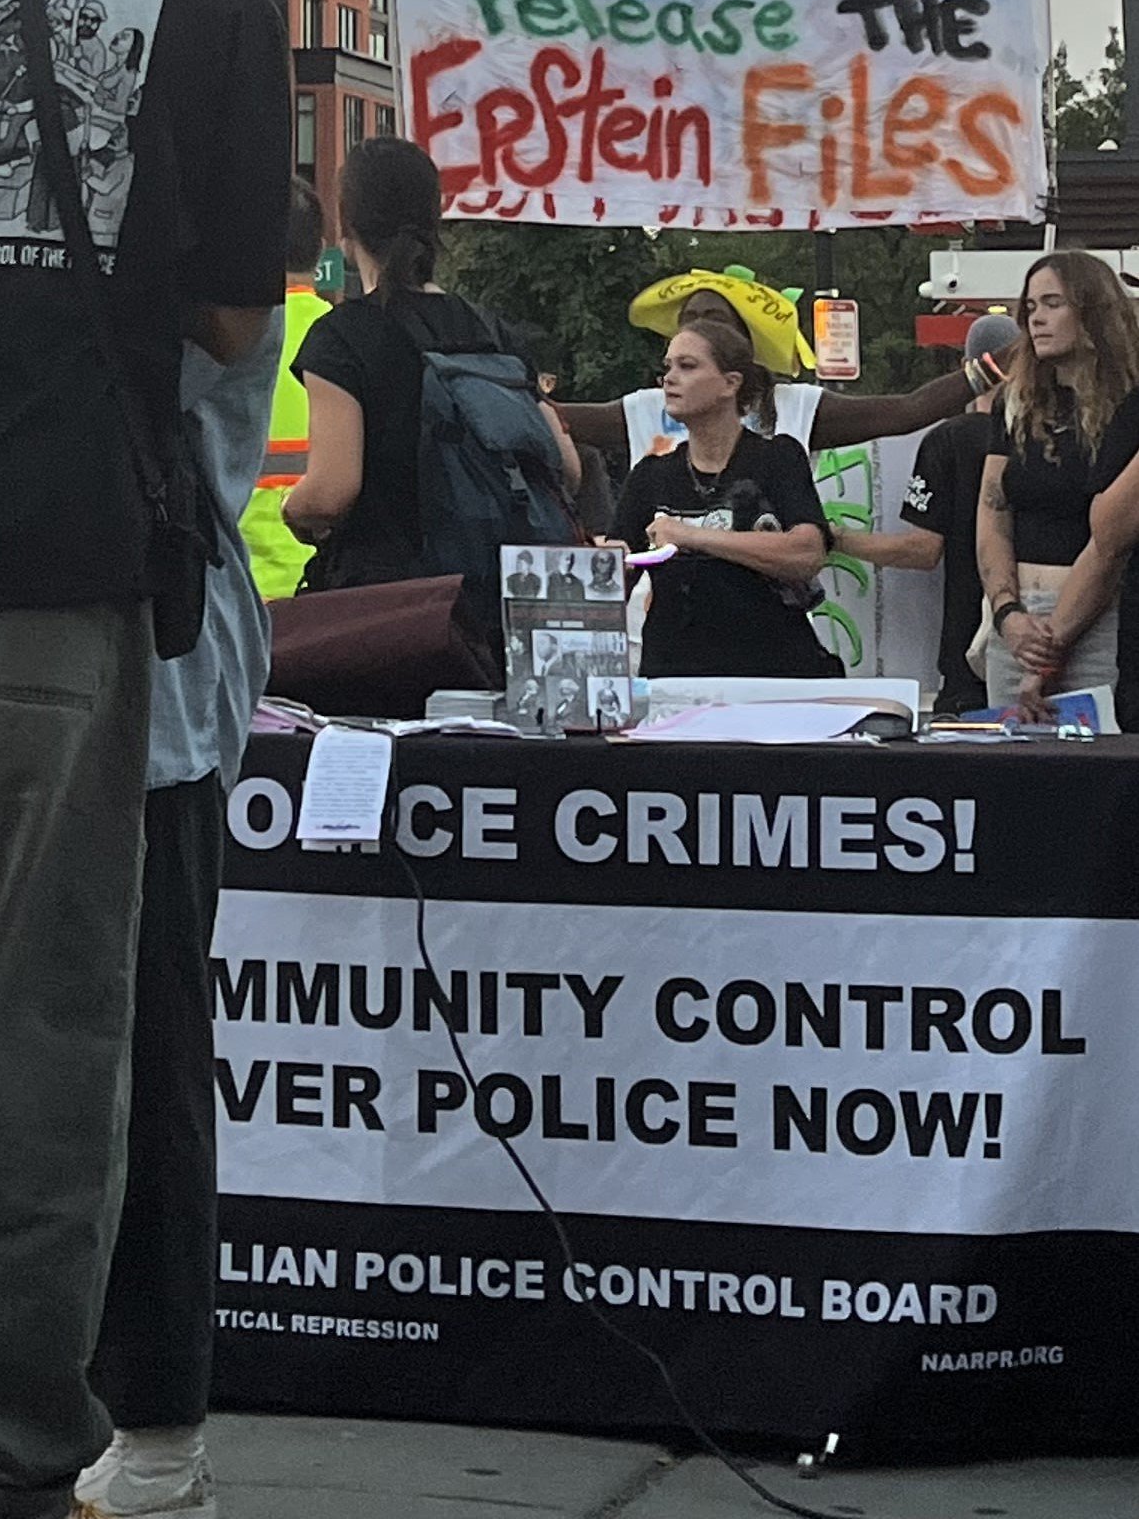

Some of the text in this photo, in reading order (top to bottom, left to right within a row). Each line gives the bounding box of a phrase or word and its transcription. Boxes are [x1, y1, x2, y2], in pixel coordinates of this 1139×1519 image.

[21, 245, 39, 267] OF
[41, 247, 65, 268] THE
[554, 788, 976, 873] CRIMES!
[655, 977, 1087, 1056] CONTROL
[416, 1068, 738, 1148] POLICE
[772, 1084, 1004, 1159] NOW!
[219, 1242, 338, 1289] LIAN
[355, 1251, 545, 1300] POLICE
[563, 1263, 805, 1319] CONTROL
[821, 1279, 998, 1324] BOARD
[290, 1314, 439, 1341] REPRESSION
[922, 1346, 1064, 1372] NAARPR.ORG
